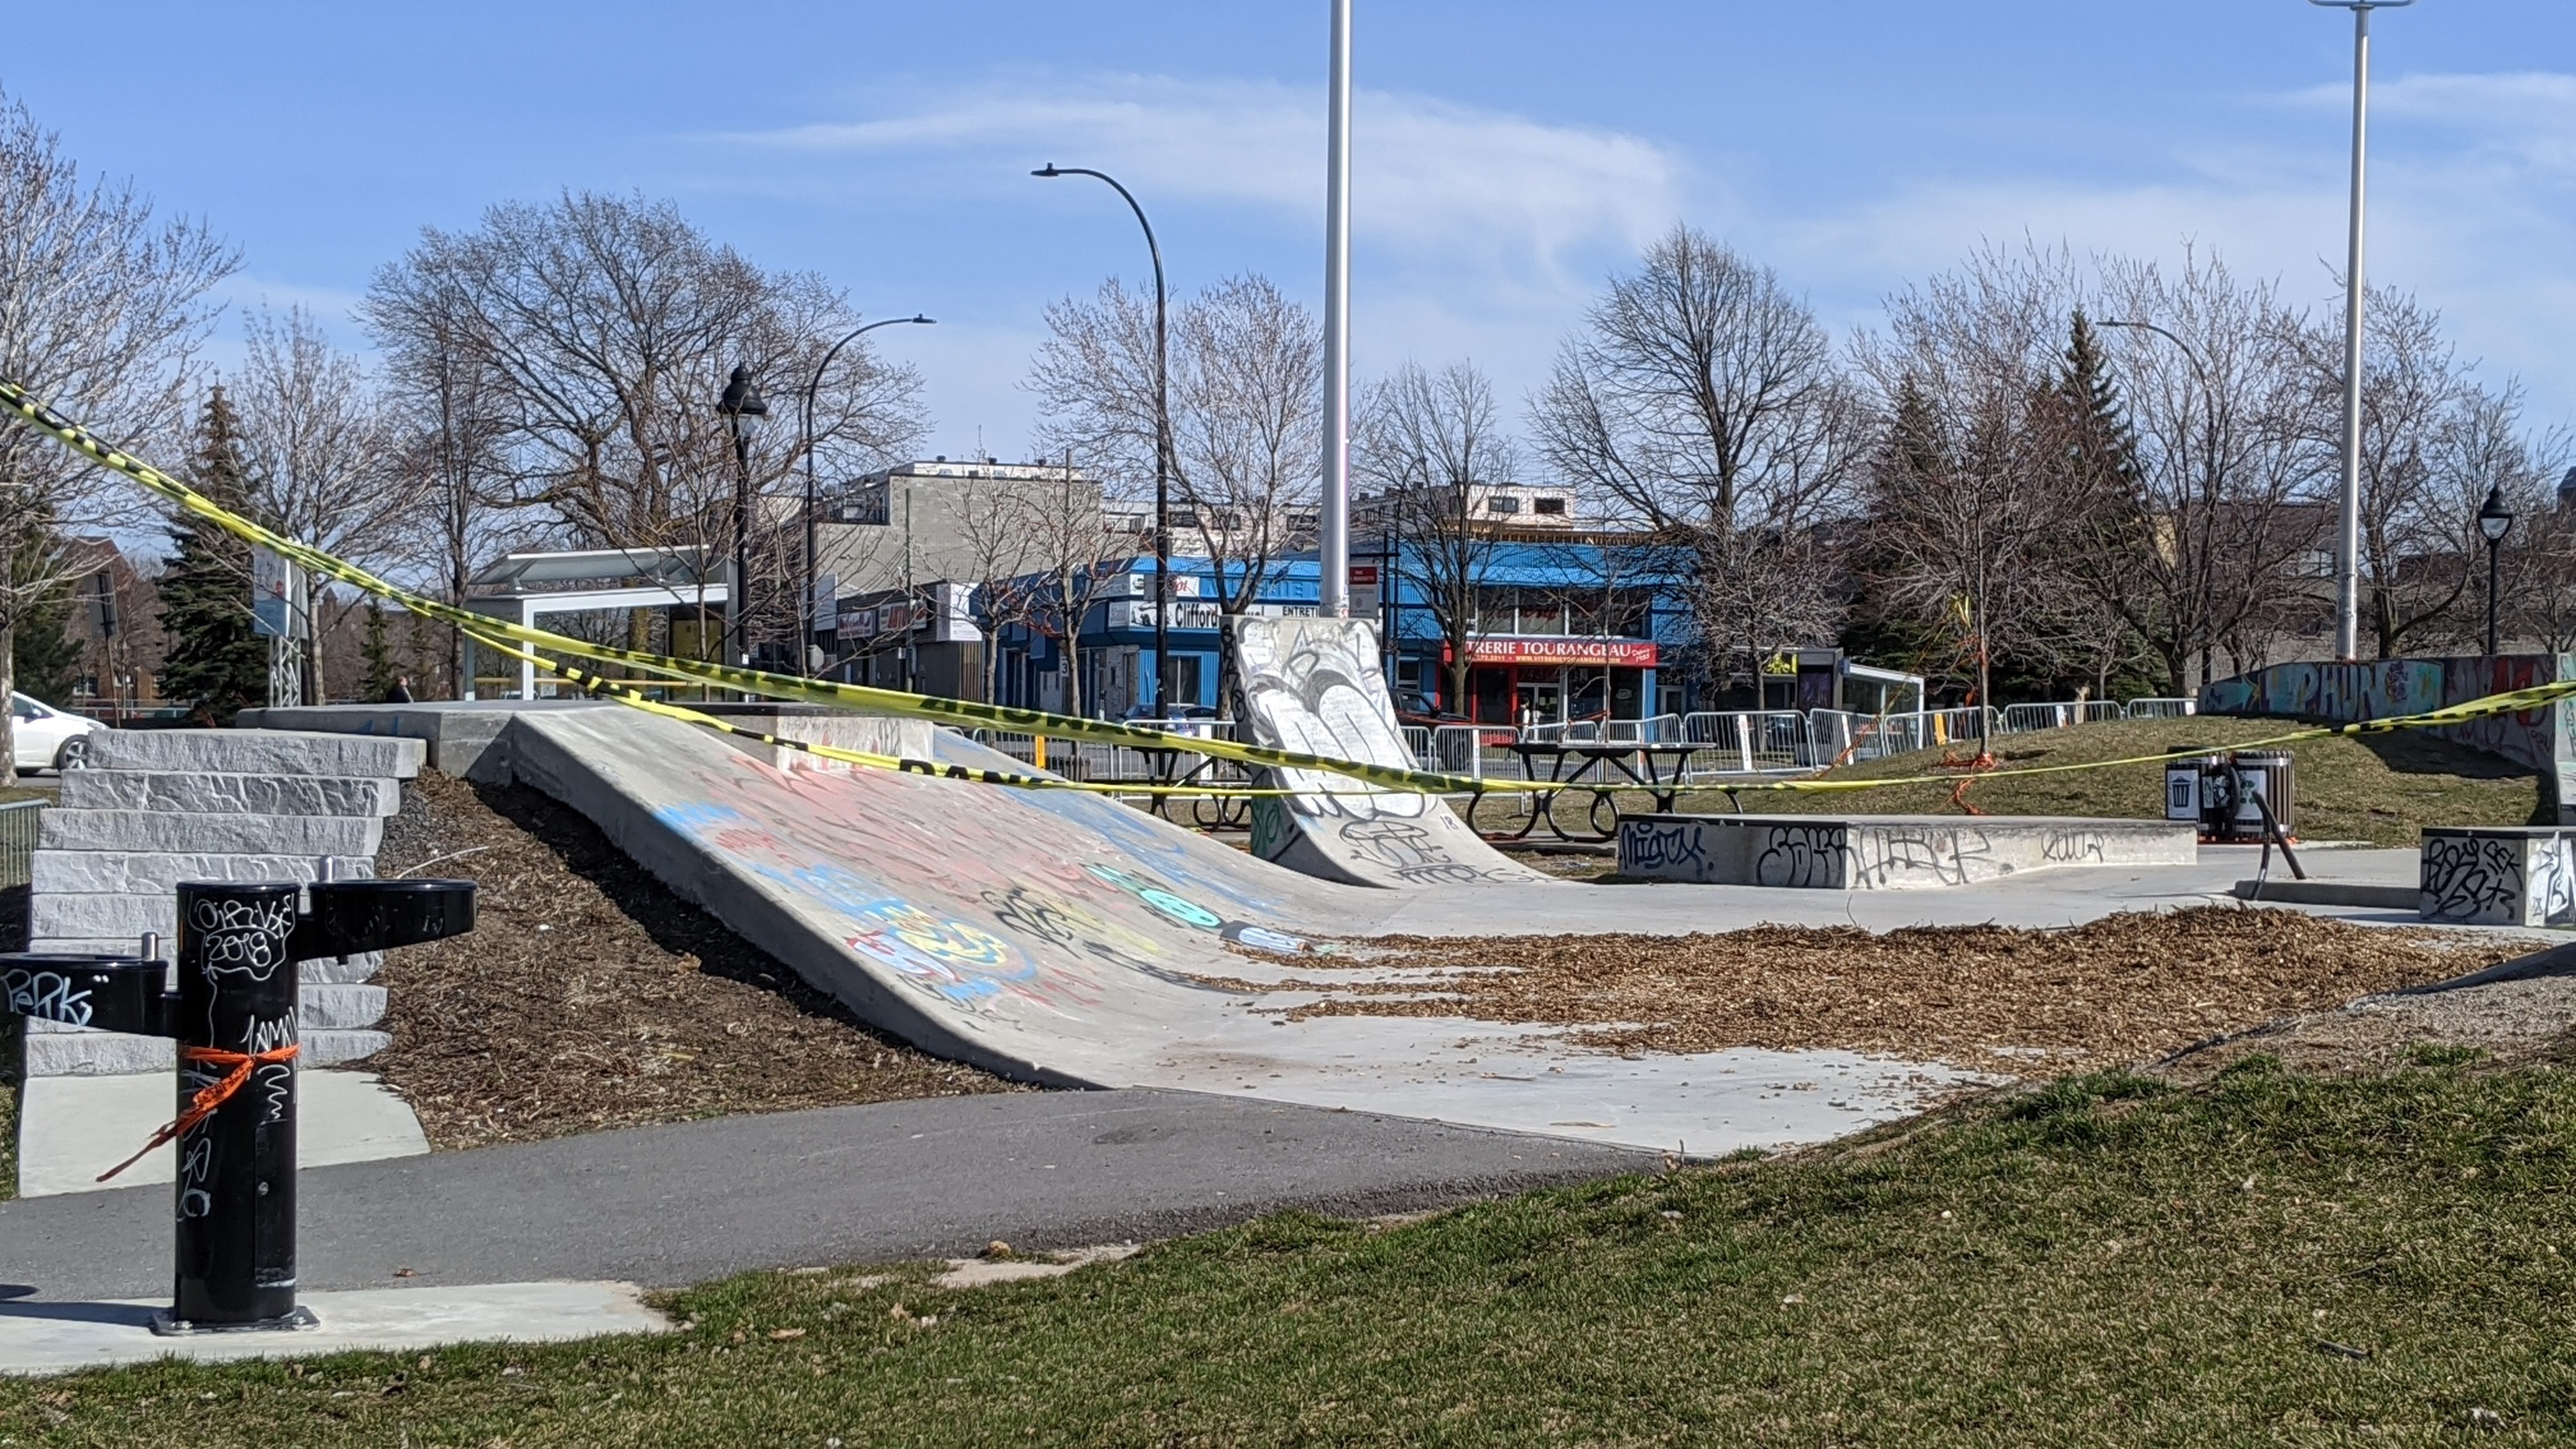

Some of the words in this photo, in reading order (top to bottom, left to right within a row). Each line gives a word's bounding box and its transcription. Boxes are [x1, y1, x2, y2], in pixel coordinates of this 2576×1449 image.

[1176, 602, 1218, 627] Clifford
[1283, 606, 1319, 617] ENTRETI
[1466, 641, 1516, 654] TRERIE
[1522, 641, 1631, 657] TOURANGEAU
[205, 931, 272, 967] 2018
